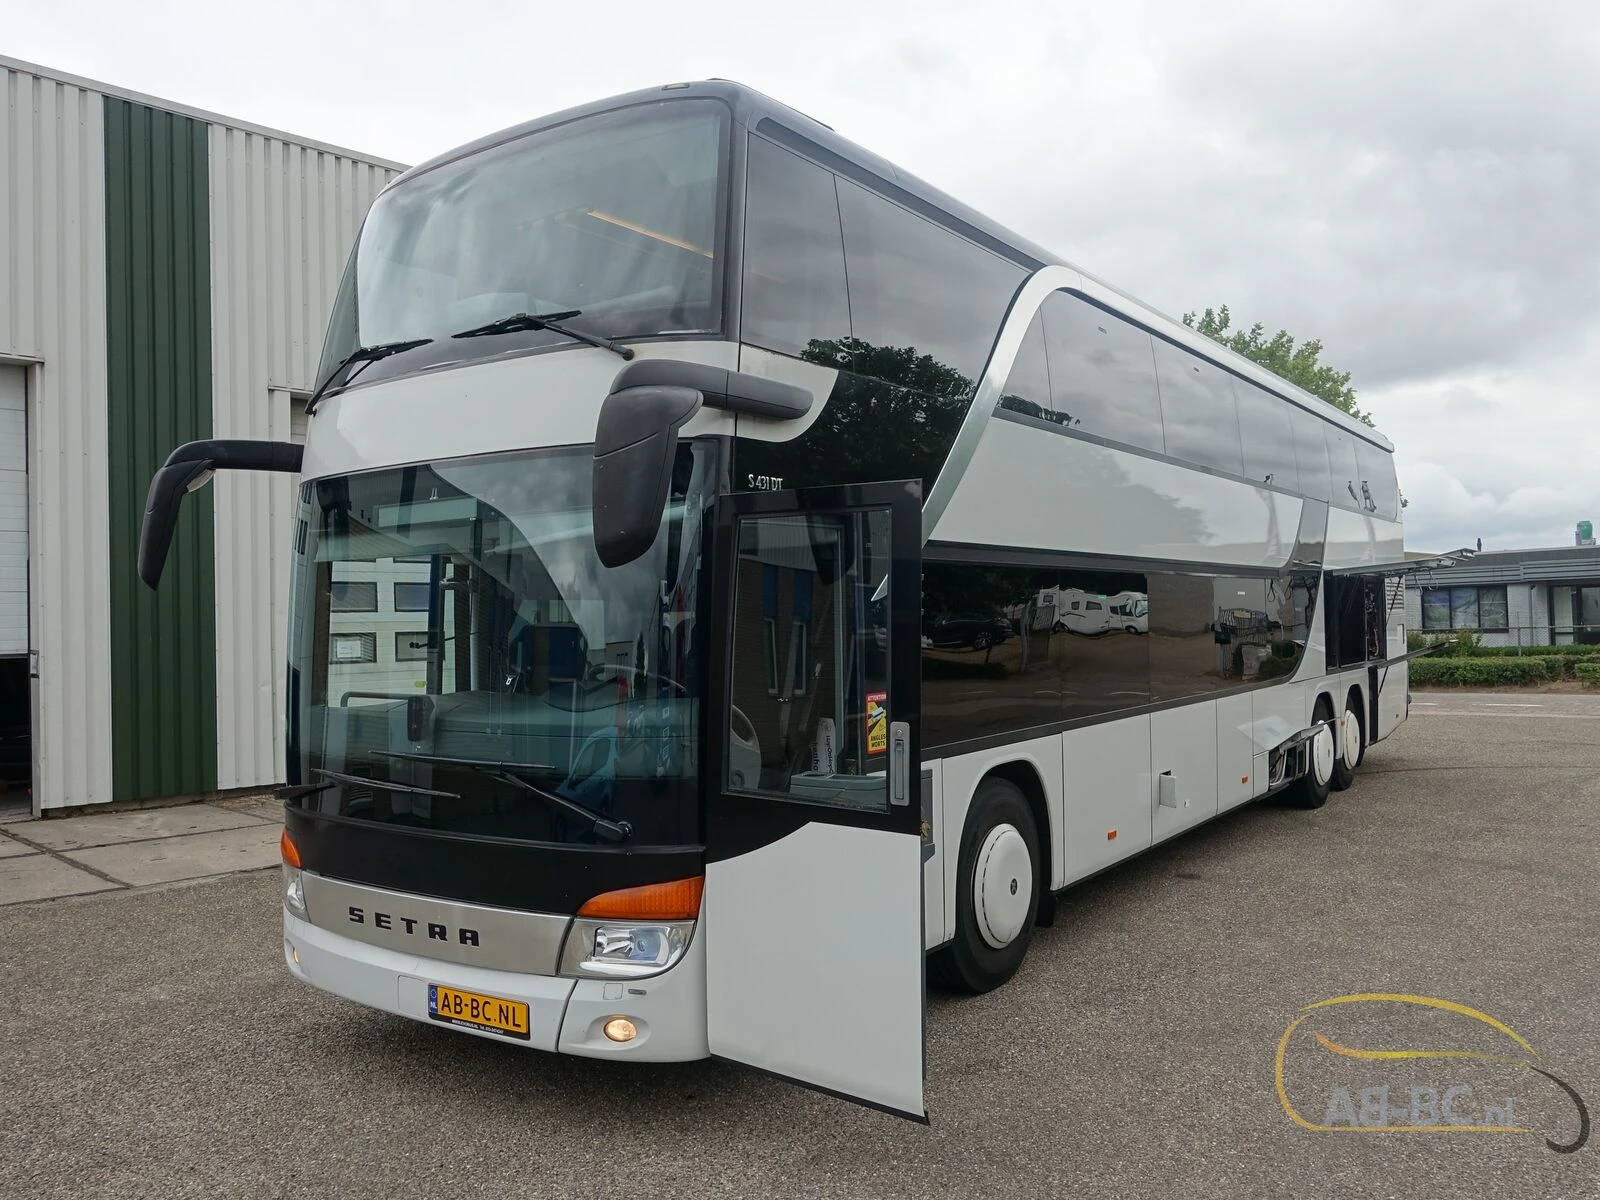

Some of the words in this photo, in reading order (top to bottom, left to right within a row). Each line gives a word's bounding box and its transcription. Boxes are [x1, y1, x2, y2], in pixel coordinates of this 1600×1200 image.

[748, 473, 755, 488] S
[756, 475, 770, 490] 431
[770, 477, 783, 491] DT
[348, 906, 480, 947] SETRA
[429, 1000, 438, 1009] NL
[441, 992, 522, 1029] AB-BC.NL
